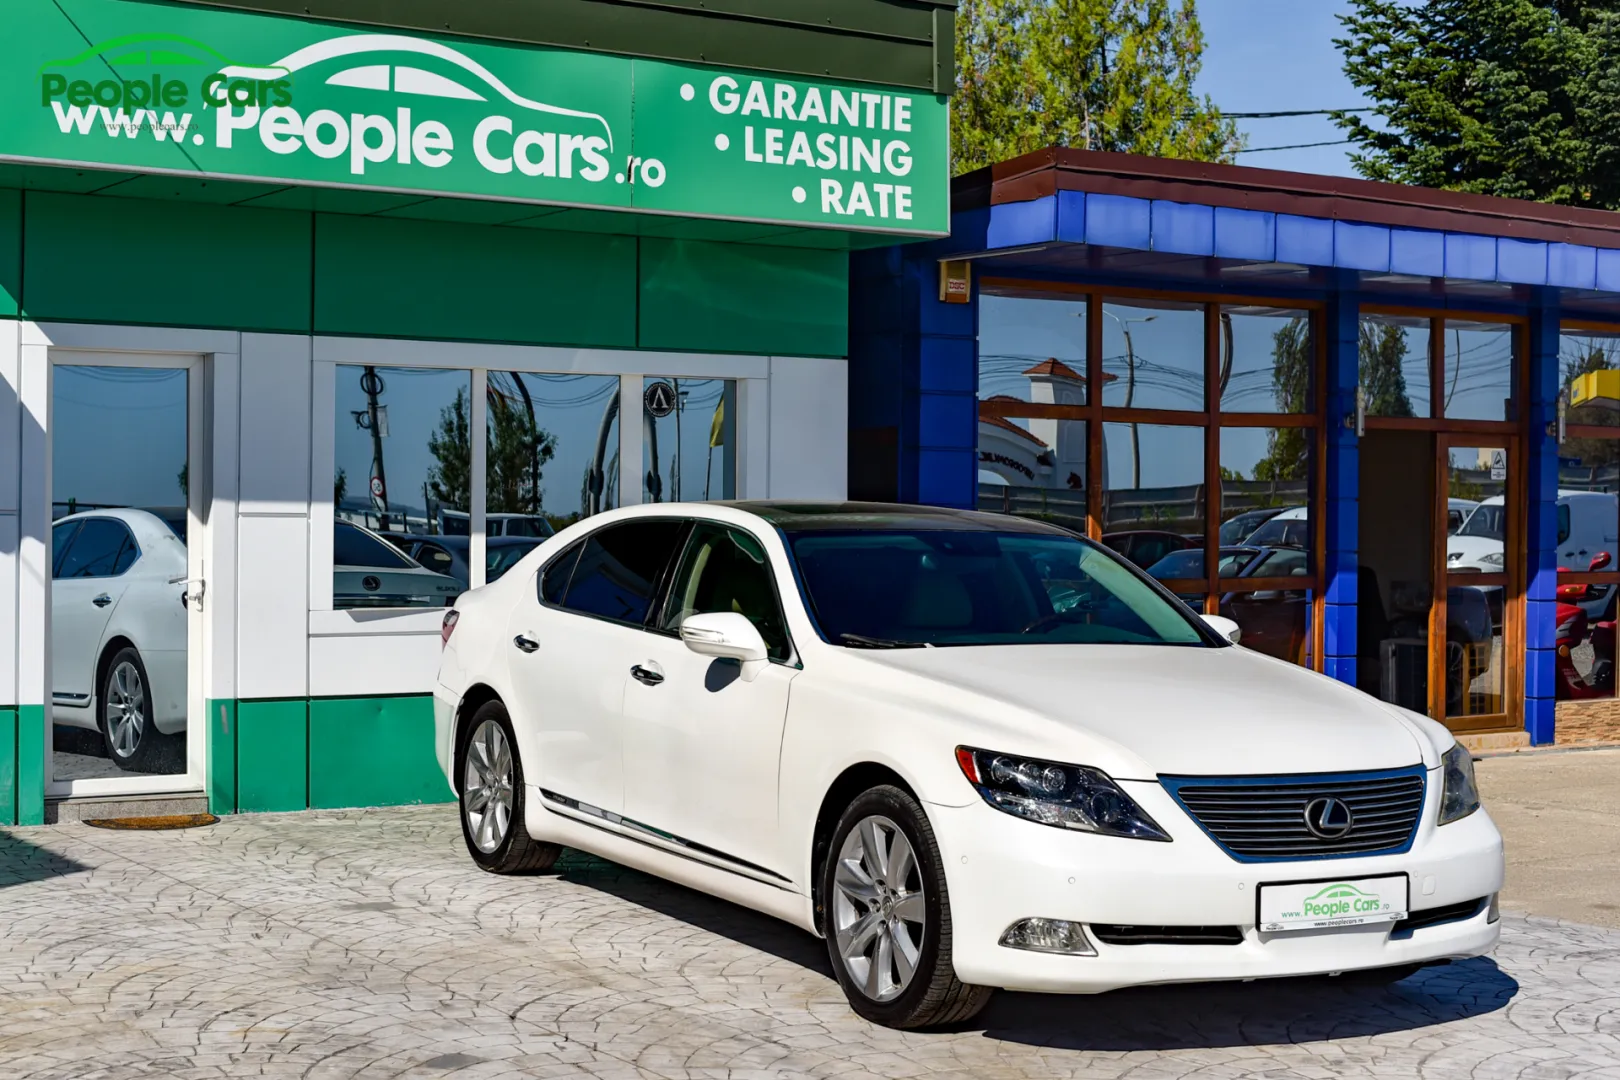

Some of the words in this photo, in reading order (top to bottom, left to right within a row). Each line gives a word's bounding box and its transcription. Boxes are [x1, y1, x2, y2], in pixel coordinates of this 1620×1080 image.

[708, 76, 912, 133] GARANTIE
[744, 126, 913, 177] LEASING
[821, 178, 913, 221] RATE
